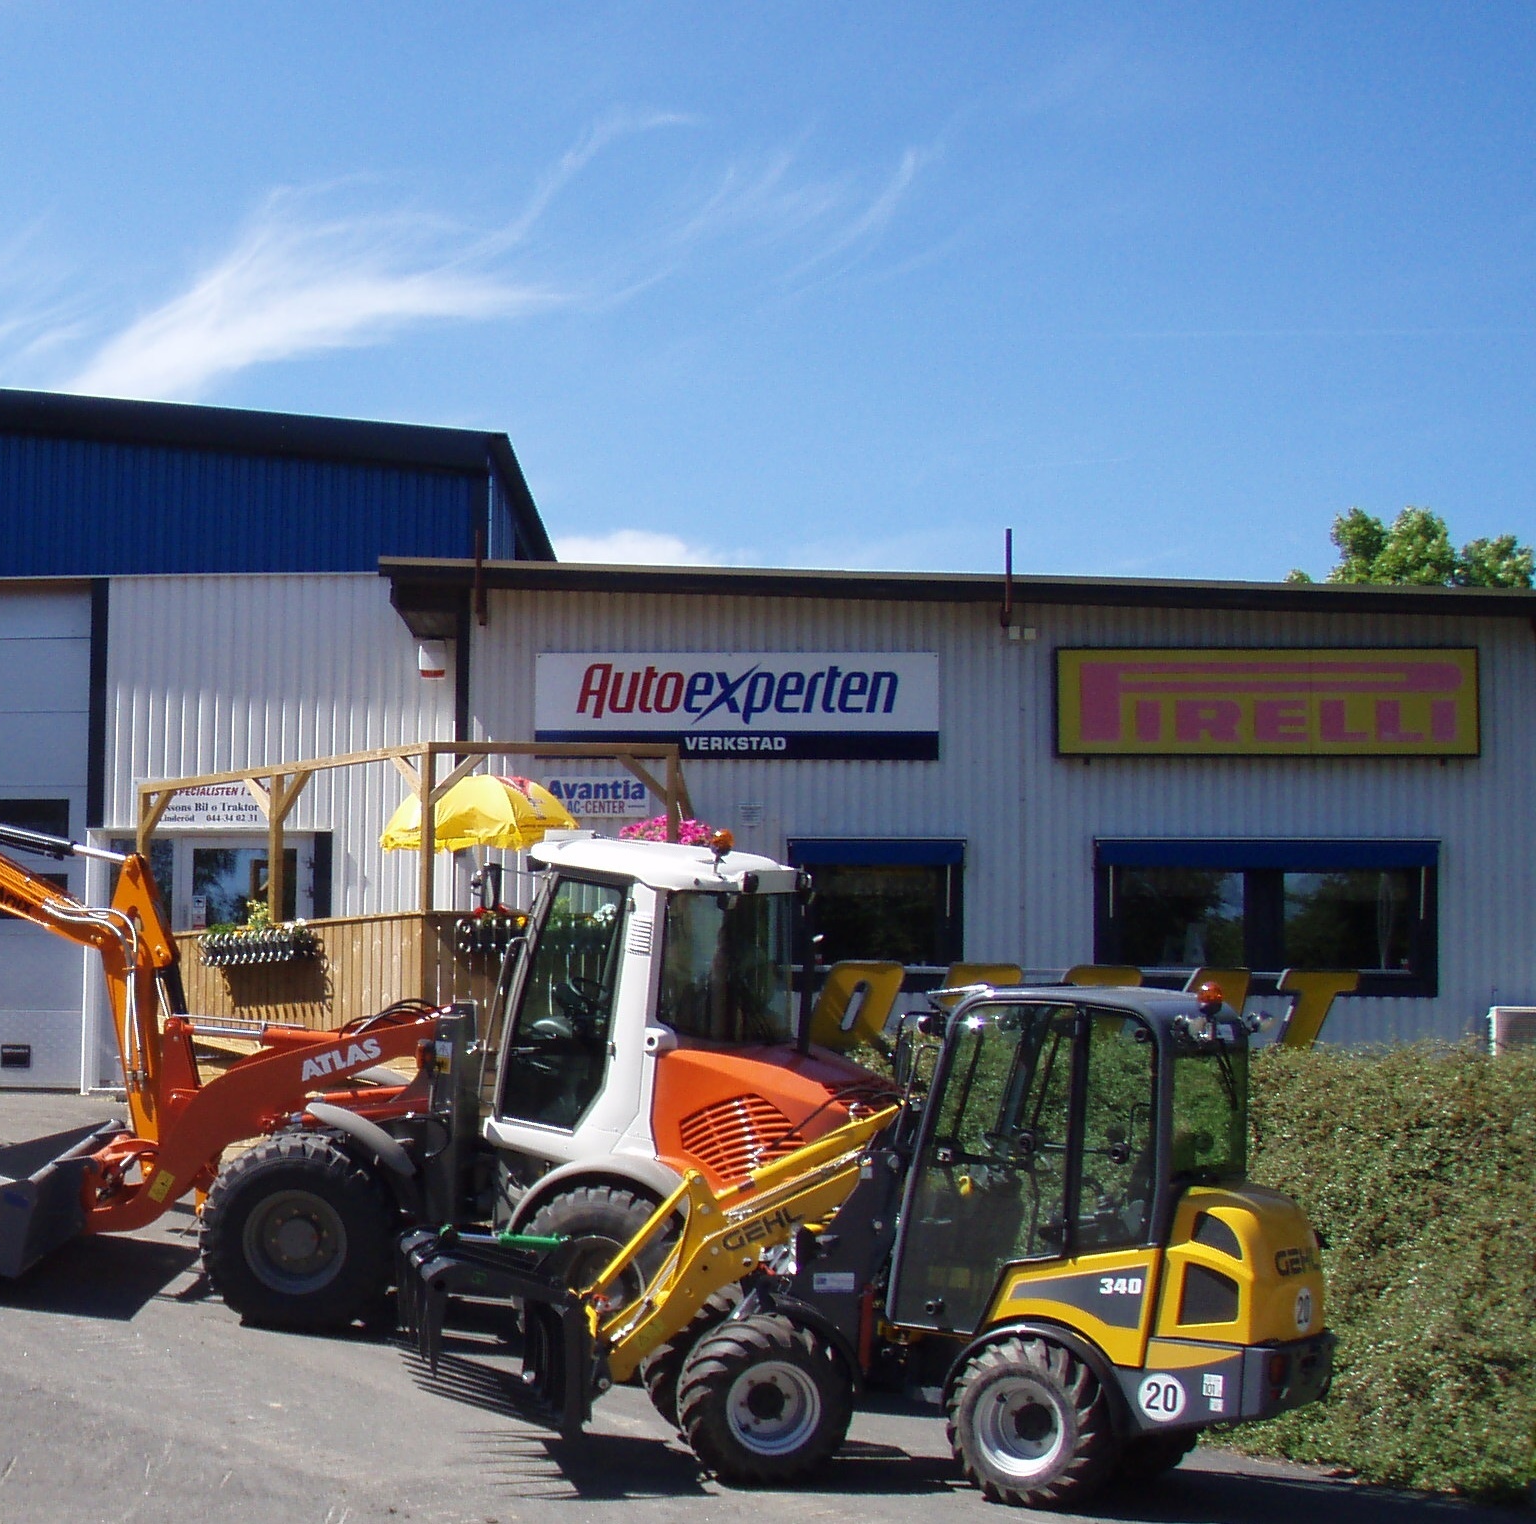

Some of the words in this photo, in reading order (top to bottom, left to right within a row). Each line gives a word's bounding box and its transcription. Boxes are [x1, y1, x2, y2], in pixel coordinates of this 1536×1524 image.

[576, 662, 898, 725] Autoexperten
[1079, 662, 1463, 743] PIRELLI
[684, 736, 787, 752] VERKSTAD
[549, 779, 645, 800] Avantia
[165, 804, 192, 812] ssons
[194, 802, 208, 812] Bil
[220, 802, 259, 812] Traktor
[567, 800, 625, 814] AC-CENTER
[301, 1038, 382, 1082] ATLAS
[722, 1207, 804, 1251] GEHL
[1099, 1277, 1143, 1295] 340
[1296, 1294, 1310, 1325] 20
[1144, 1381, 1177, 1413] 20
